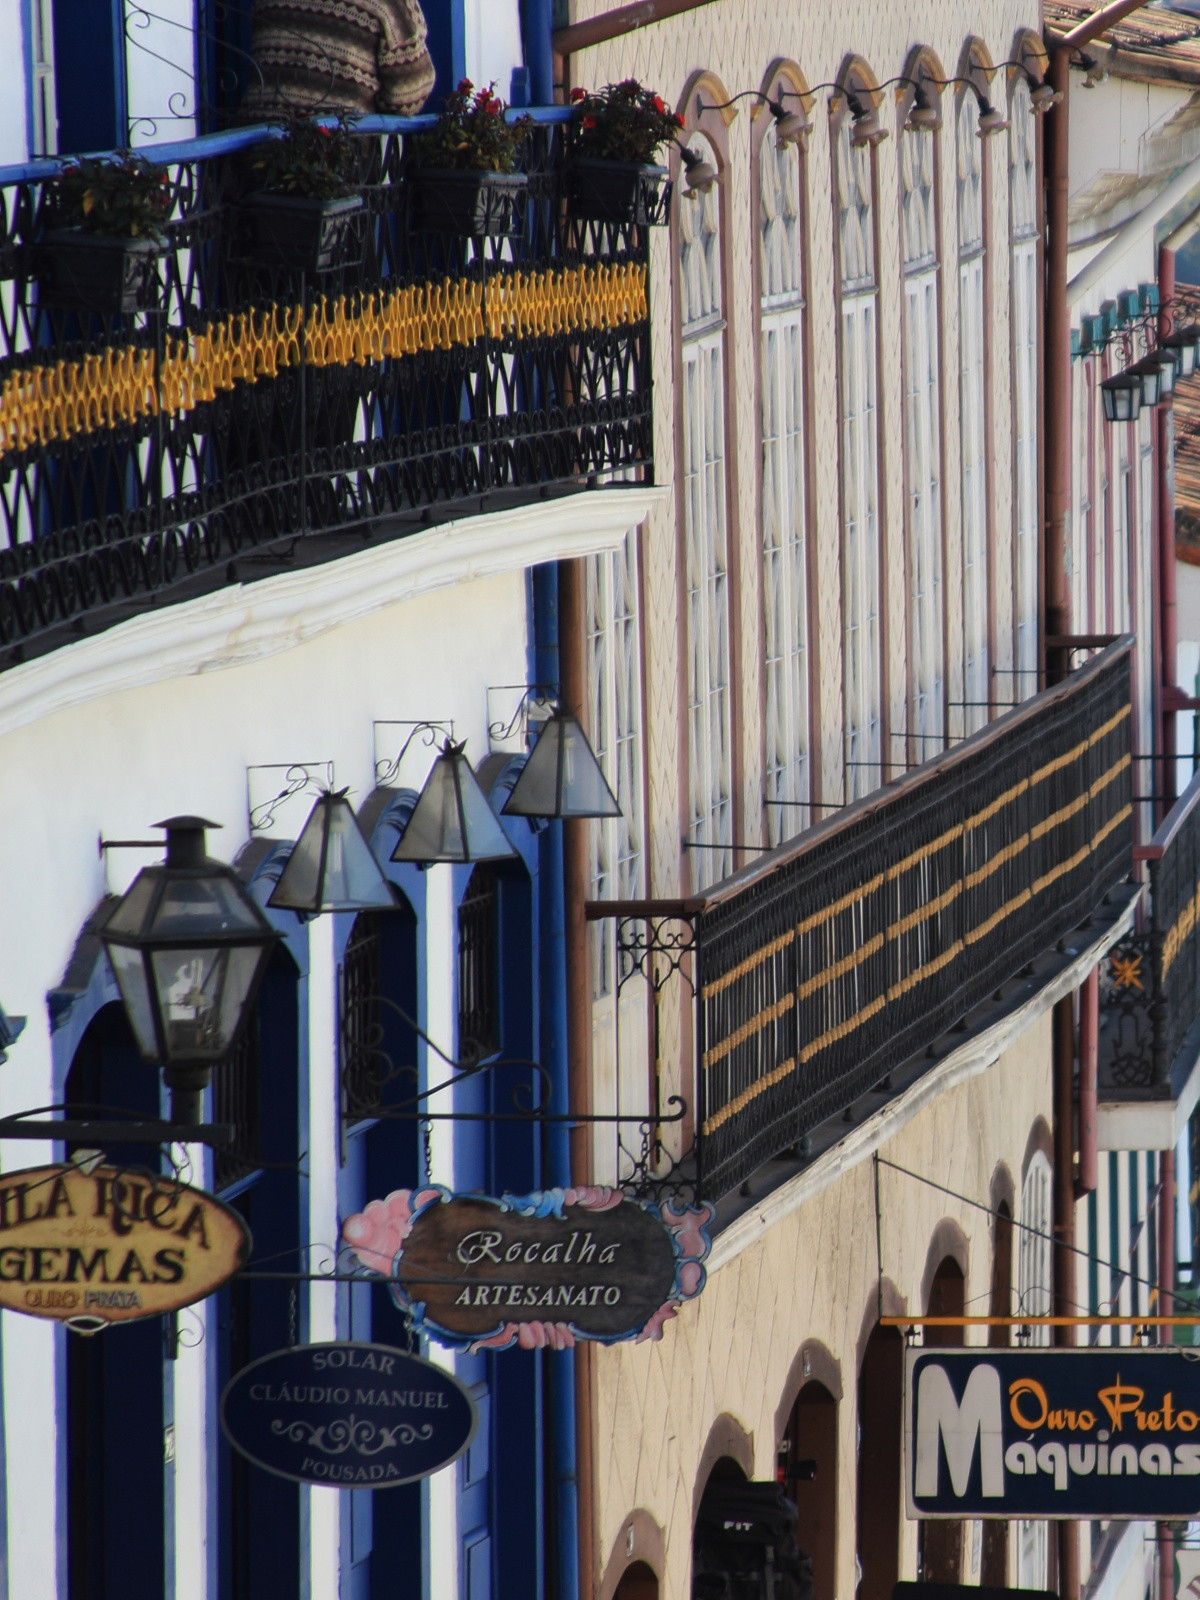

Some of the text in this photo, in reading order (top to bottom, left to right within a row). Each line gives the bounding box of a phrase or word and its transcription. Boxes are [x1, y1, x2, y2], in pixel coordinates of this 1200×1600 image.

[95, 1177, 210, 1249] RICA
[456, 1230, 622, 1265] Rocalha
[0, 1247, 185, 1283] GEMAS
[25, 1289, 141, 1308] OURO PRATA
[454, 1285, 622, 1306] ARTESANATO
[312, 1351, 395, 1374] SOLAR
[250, 1381, 449, 1409] CLÁUDIO MANUEL
[1009, 1378, 1097, 1430] Ouro
[302, 1458, 399, 1480] POUSADA
